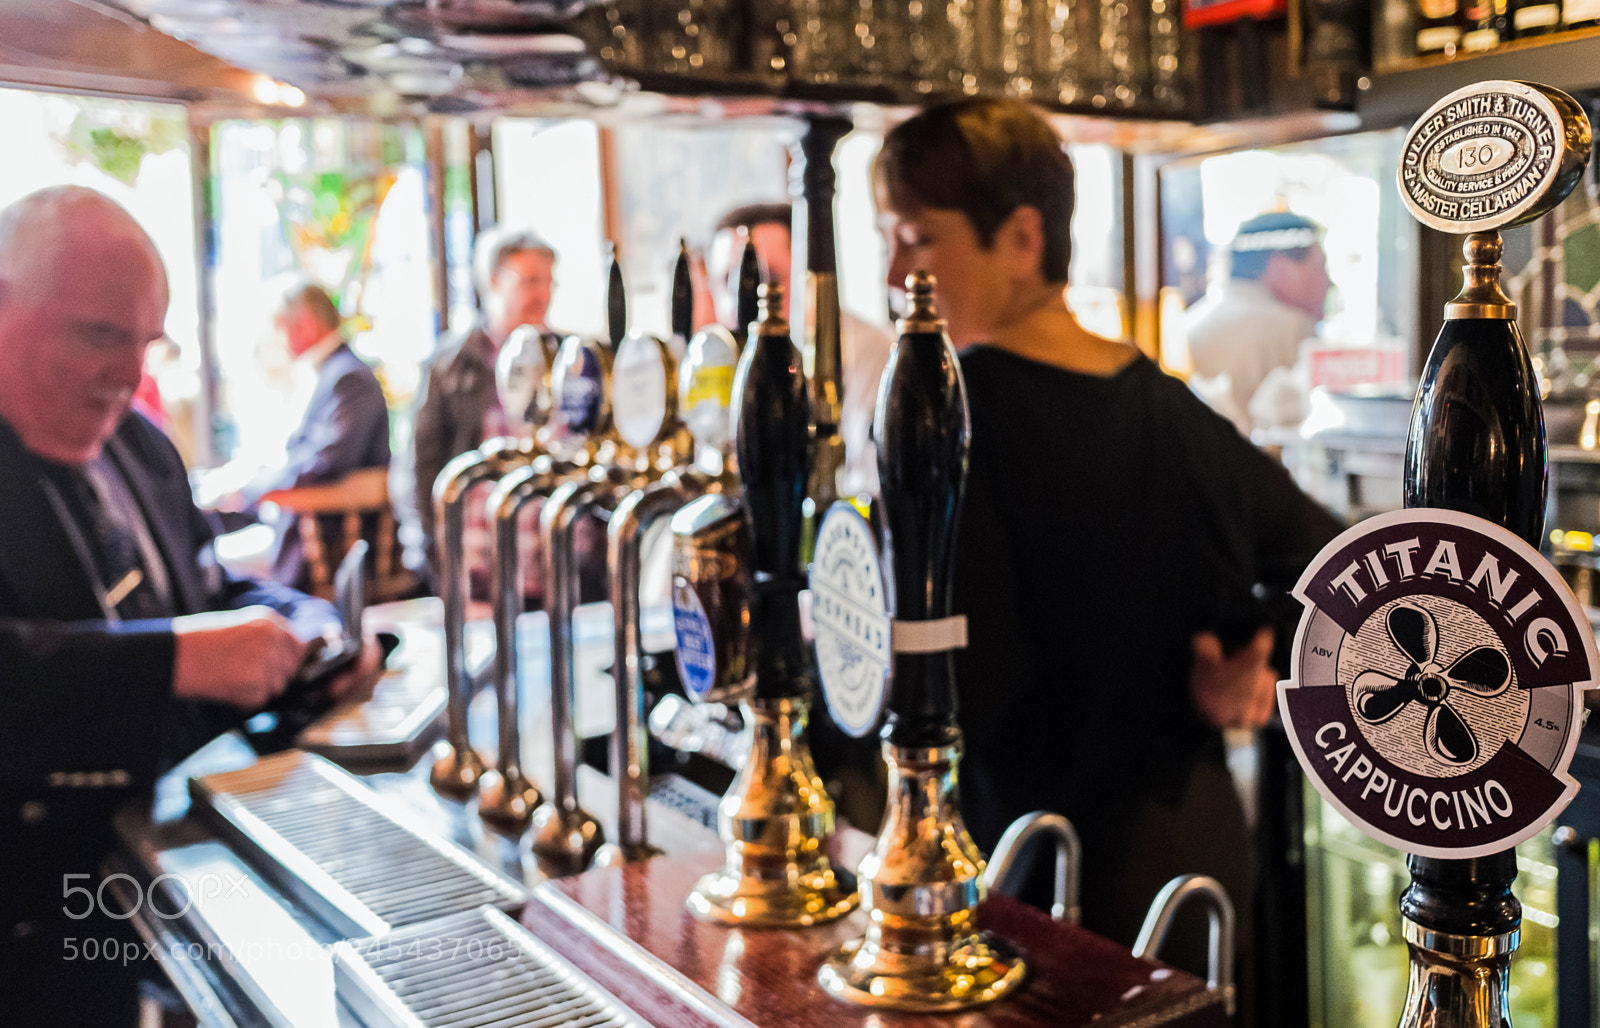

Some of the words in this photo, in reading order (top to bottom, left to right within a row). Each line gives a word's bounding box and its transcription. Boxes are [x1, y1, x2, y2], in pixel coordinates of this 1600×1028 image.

[1405, 114, 1445, 181] FULLER
[1447, 97, 1490, 122] SMITH
[1494, 97, 1504, 113] &
[1509, 98, 1553, 160] TURNER
[1433, 124, 1490, 153] ESTABLISHED
[1491, 124, 1501, 134] IN
[1502, 126, 1522, 141] 1845
[1459, 144, 1493, 168] 130
[1411, 183, 1457, 218] MASTER
[1460, 166, 1542, 218] CELLARMAN
[1427, 169, 1457, 191] QUALITY
[1458, 178, 1493, 192] SERVICE
[1502, 155, 1527, 181] PRIDE
[1327, 536, 1570, 670] TITANIC
[1311, 645, 1333, 659] ABV
[1533, 716, 1560, 732] 4.5%
[1314, 720, 1514, 831] CAPPUCCINO
